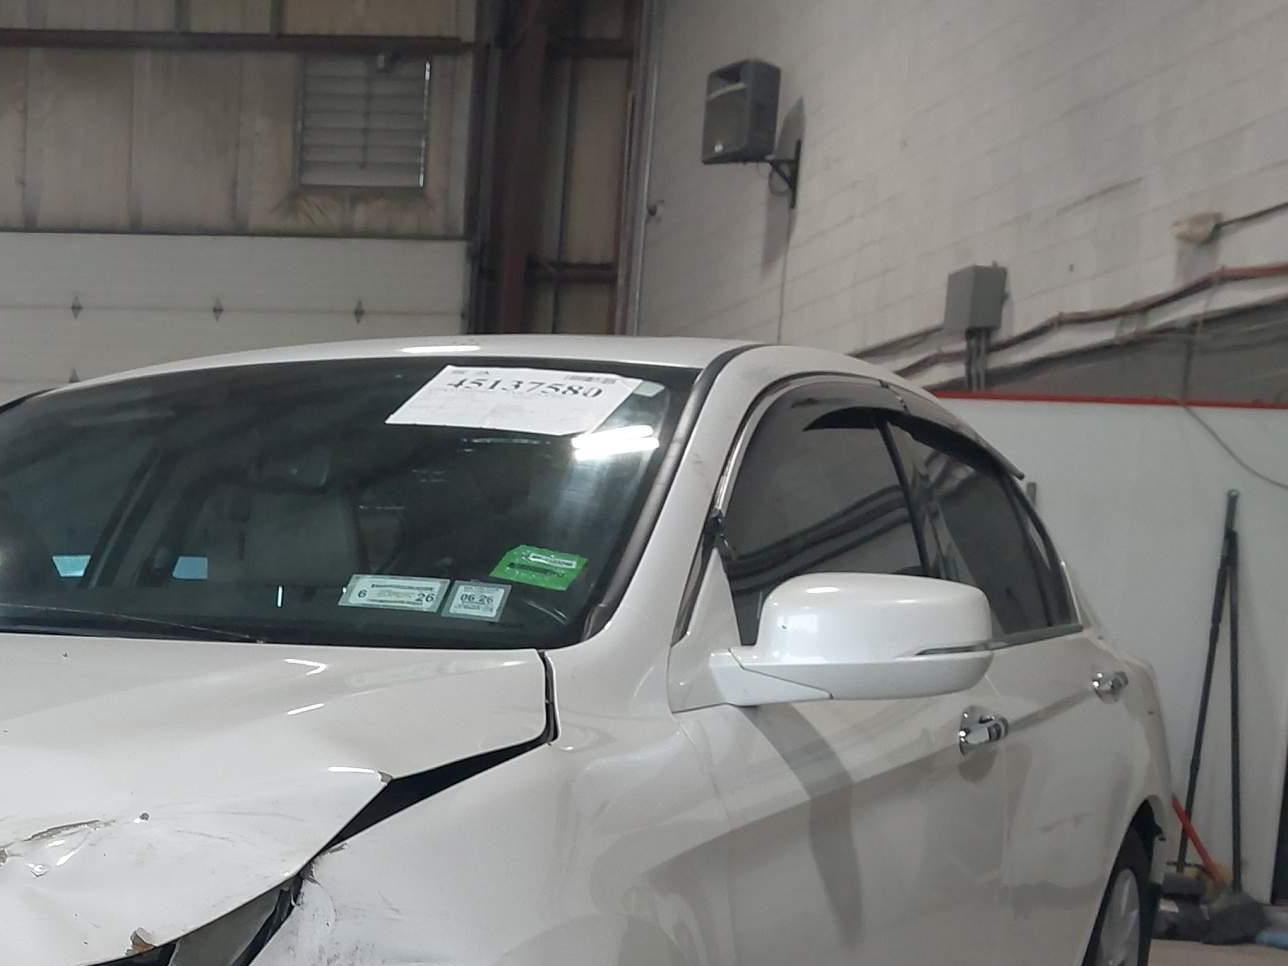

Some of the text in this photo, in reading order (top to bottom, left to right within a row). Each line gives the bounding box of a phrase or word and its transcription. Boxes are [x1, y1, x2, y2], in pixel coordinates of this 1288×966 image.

[447, 378, 603, 399] 45137580
[357, 588, 368, 599] 6
[415, 592, 435, 603] 26
